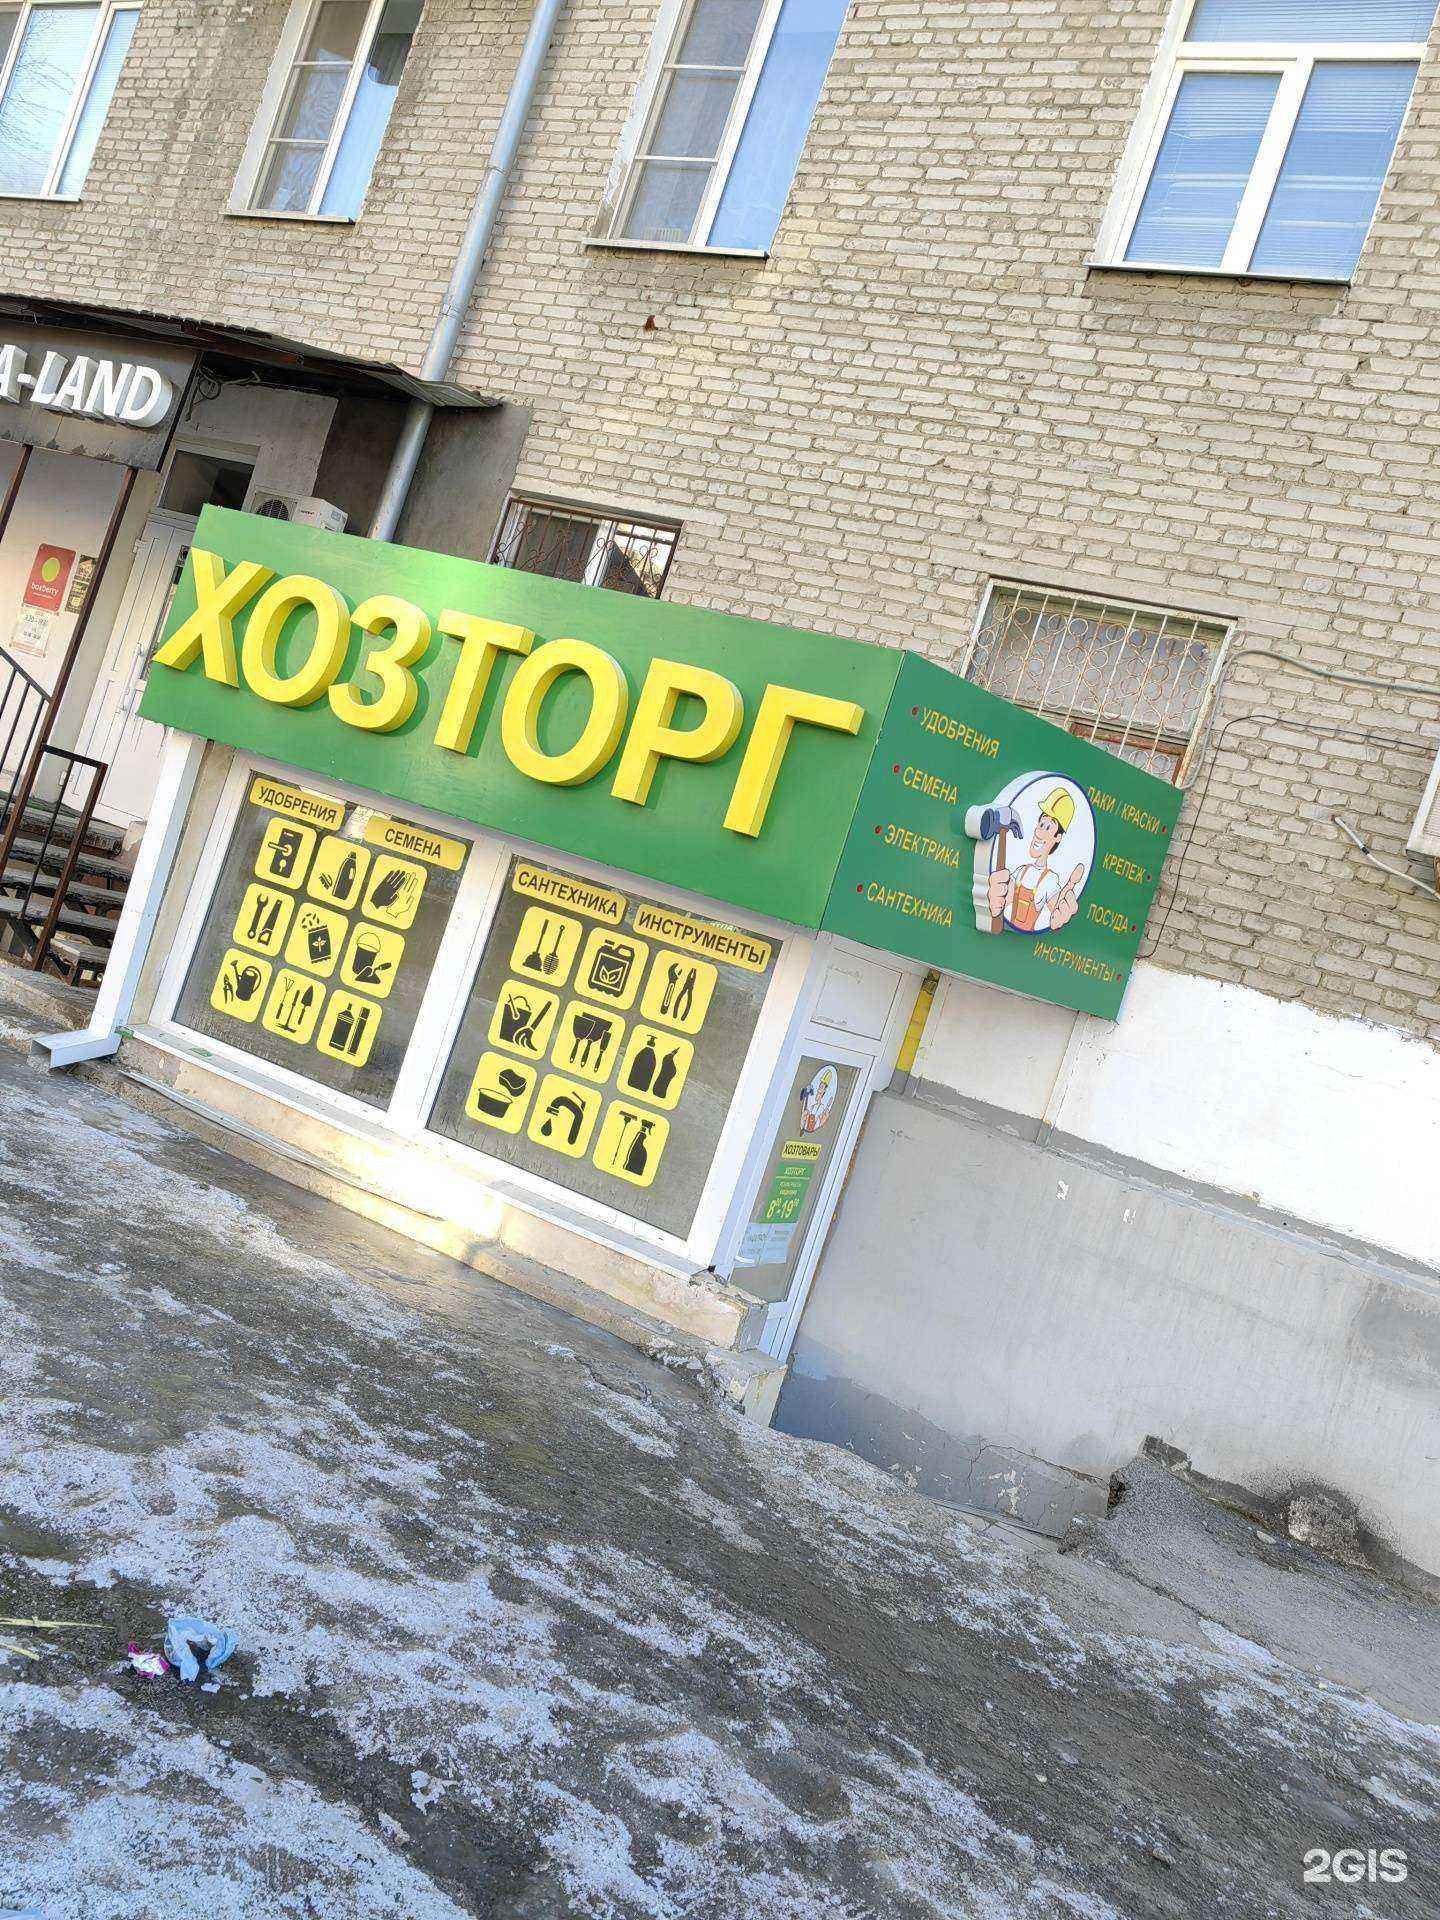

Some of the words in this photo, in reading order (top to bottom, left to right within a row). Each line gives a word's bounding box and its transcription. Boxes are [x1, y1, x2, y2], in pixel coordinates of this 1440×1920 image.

[152, 547, 866, 840] ХОЗТОРГ
[920, 707, 1000, 758] УДОБРЕНИЯ
[258, 786, 337, 824] УДОБРЕНИЯ
[902, 765, 960, 806] СЕМЕНА
[1121, 803, 1161, 835] КРАСКИ
[384, 827, 442, 859] СЕМЕНА
[883, 823, 961, 869] ЭЛЕКТРИКА
[1103, 852, 1146, 885] КРЕПЕЖ
[517, 870, 619, 918] САНТЕХНИКА
[866, 882, 954, 929] САНТЕХНИКА
[638, 911, 767, 966] ИНСТРУМЕНТЫ
[1087, 902, 1130, 935] ПОСУДА
[1033, 941, 1113, 983] ИНСТРУМЕНТЫ
[784, 1143, 819, 1157] ХОЗТОВАРЫ
